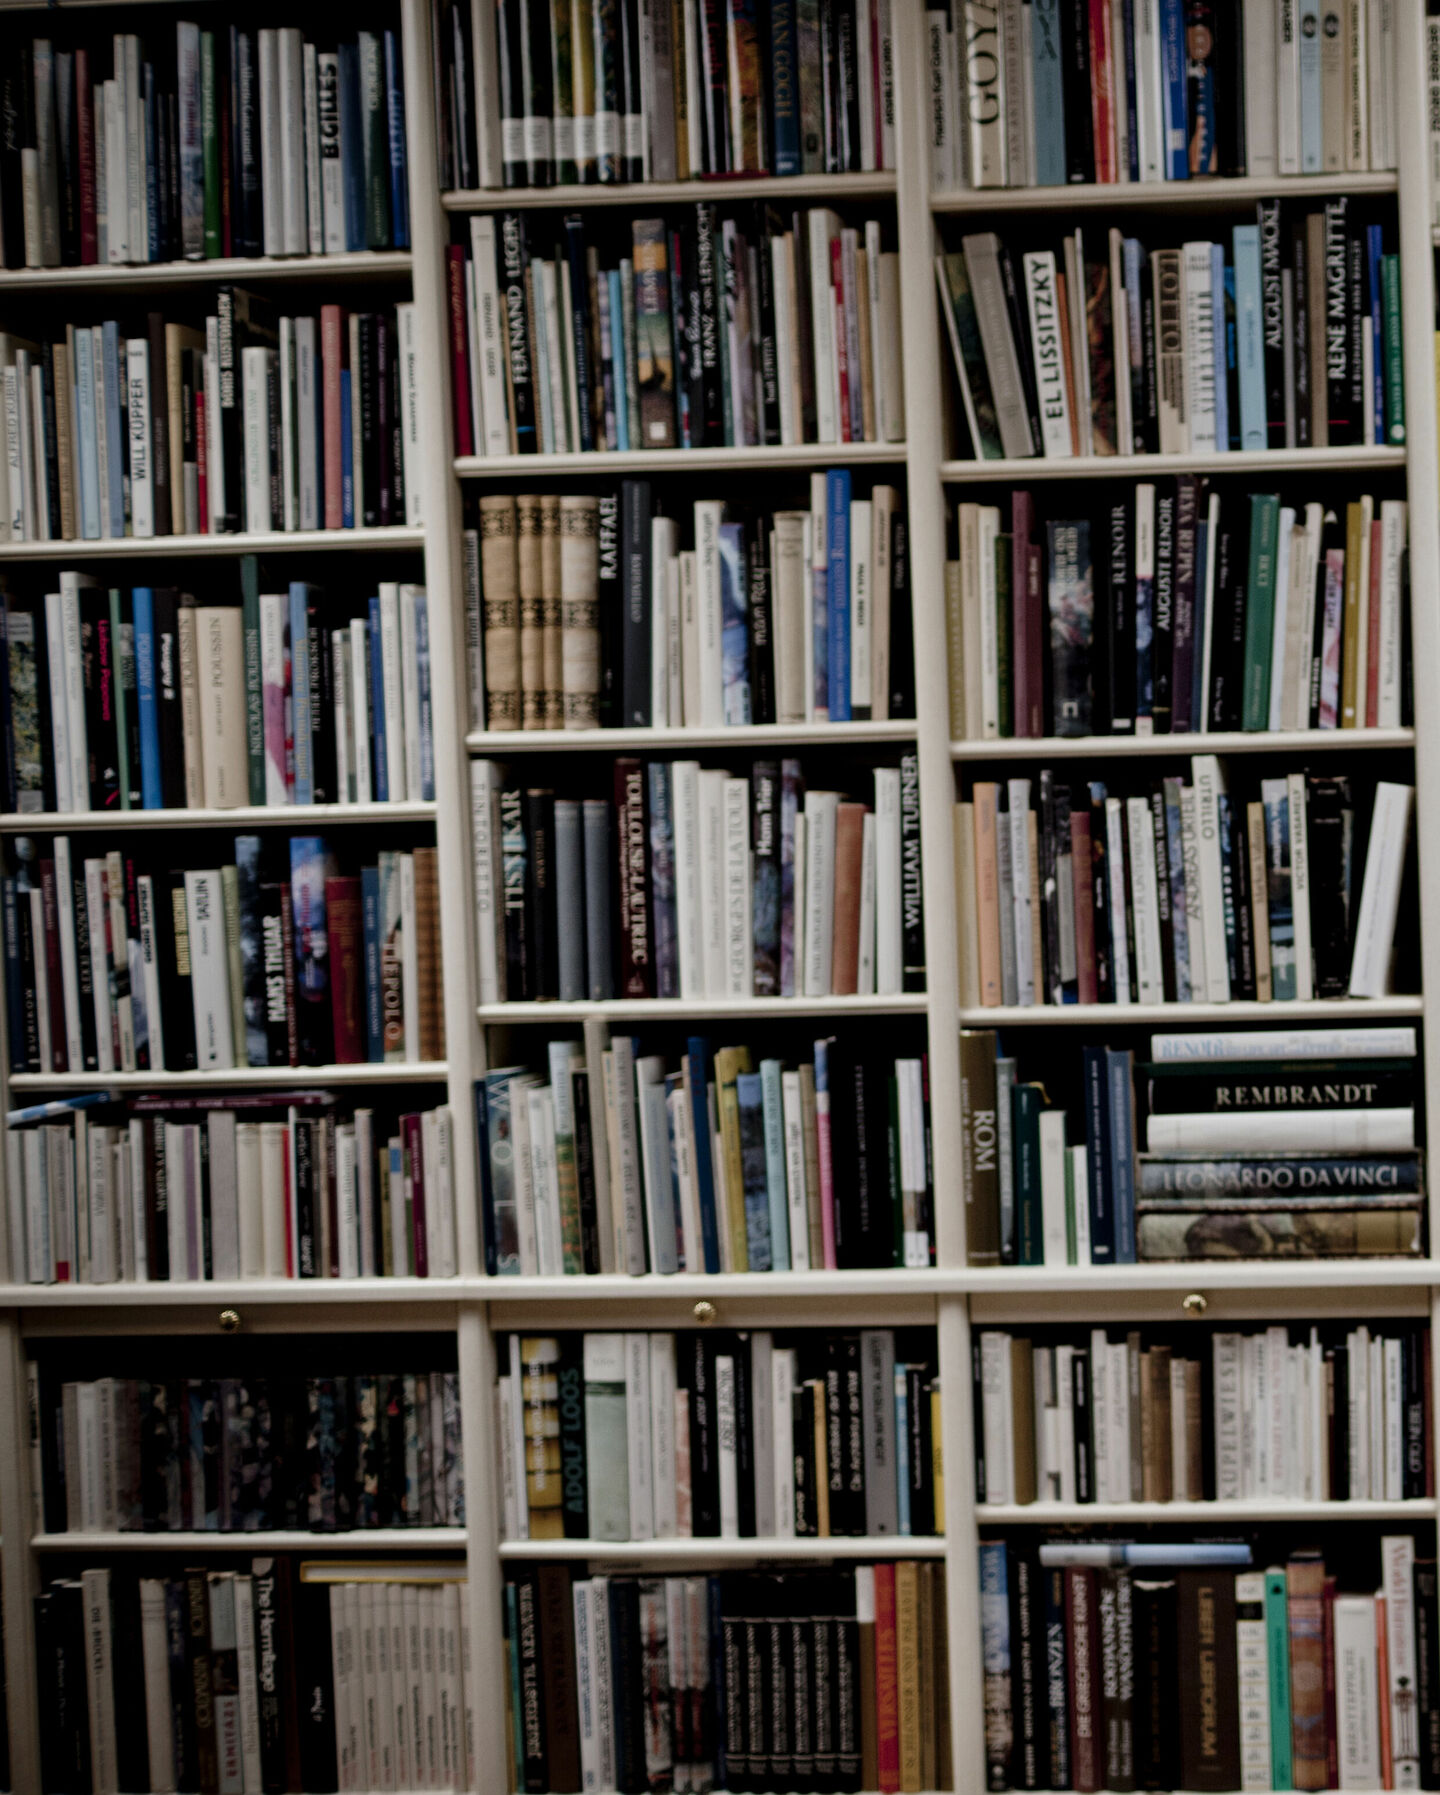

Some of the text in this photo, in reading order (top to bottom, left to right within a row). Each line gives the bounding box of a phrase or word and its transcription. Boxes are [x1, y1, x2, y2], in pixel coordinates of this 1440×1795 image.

[321, 65, 339, 158] B.GILLES
[773, 51, 794, 117] GOGH
[1326, 198, 1346, 319] MAGRITTE
[505, 285, 525, 383] FERNAND
[1030, 259, 1062, 419] EL LISSITZKY
[1263, 275, 1283, 351] AUGUST
[130, 379, 145, 480] WILL KÜPPER
[598, 495, 617, 579] RAFFAEL
[1112, 505, 1126, 584] RENOIR
[1158, 496, 1172, 556] RENOIR
[901, 757, 921, 929] WILLIAM TURNER
[1200, 776, 1214, 838] UTRILLO
[262, 915, 286, 1021] HANS THUAR
[1215, 1083, 1378, 1107] REMBRANDT
[975, 1110, 995, 1171] ROM
[1165, 1165, 1396, 1190] LEONARDO DA VINCI
[560, 1369, 584, 1513] ADOLF LOOS
[259, 1577, 277, 1692] The Hermitage
